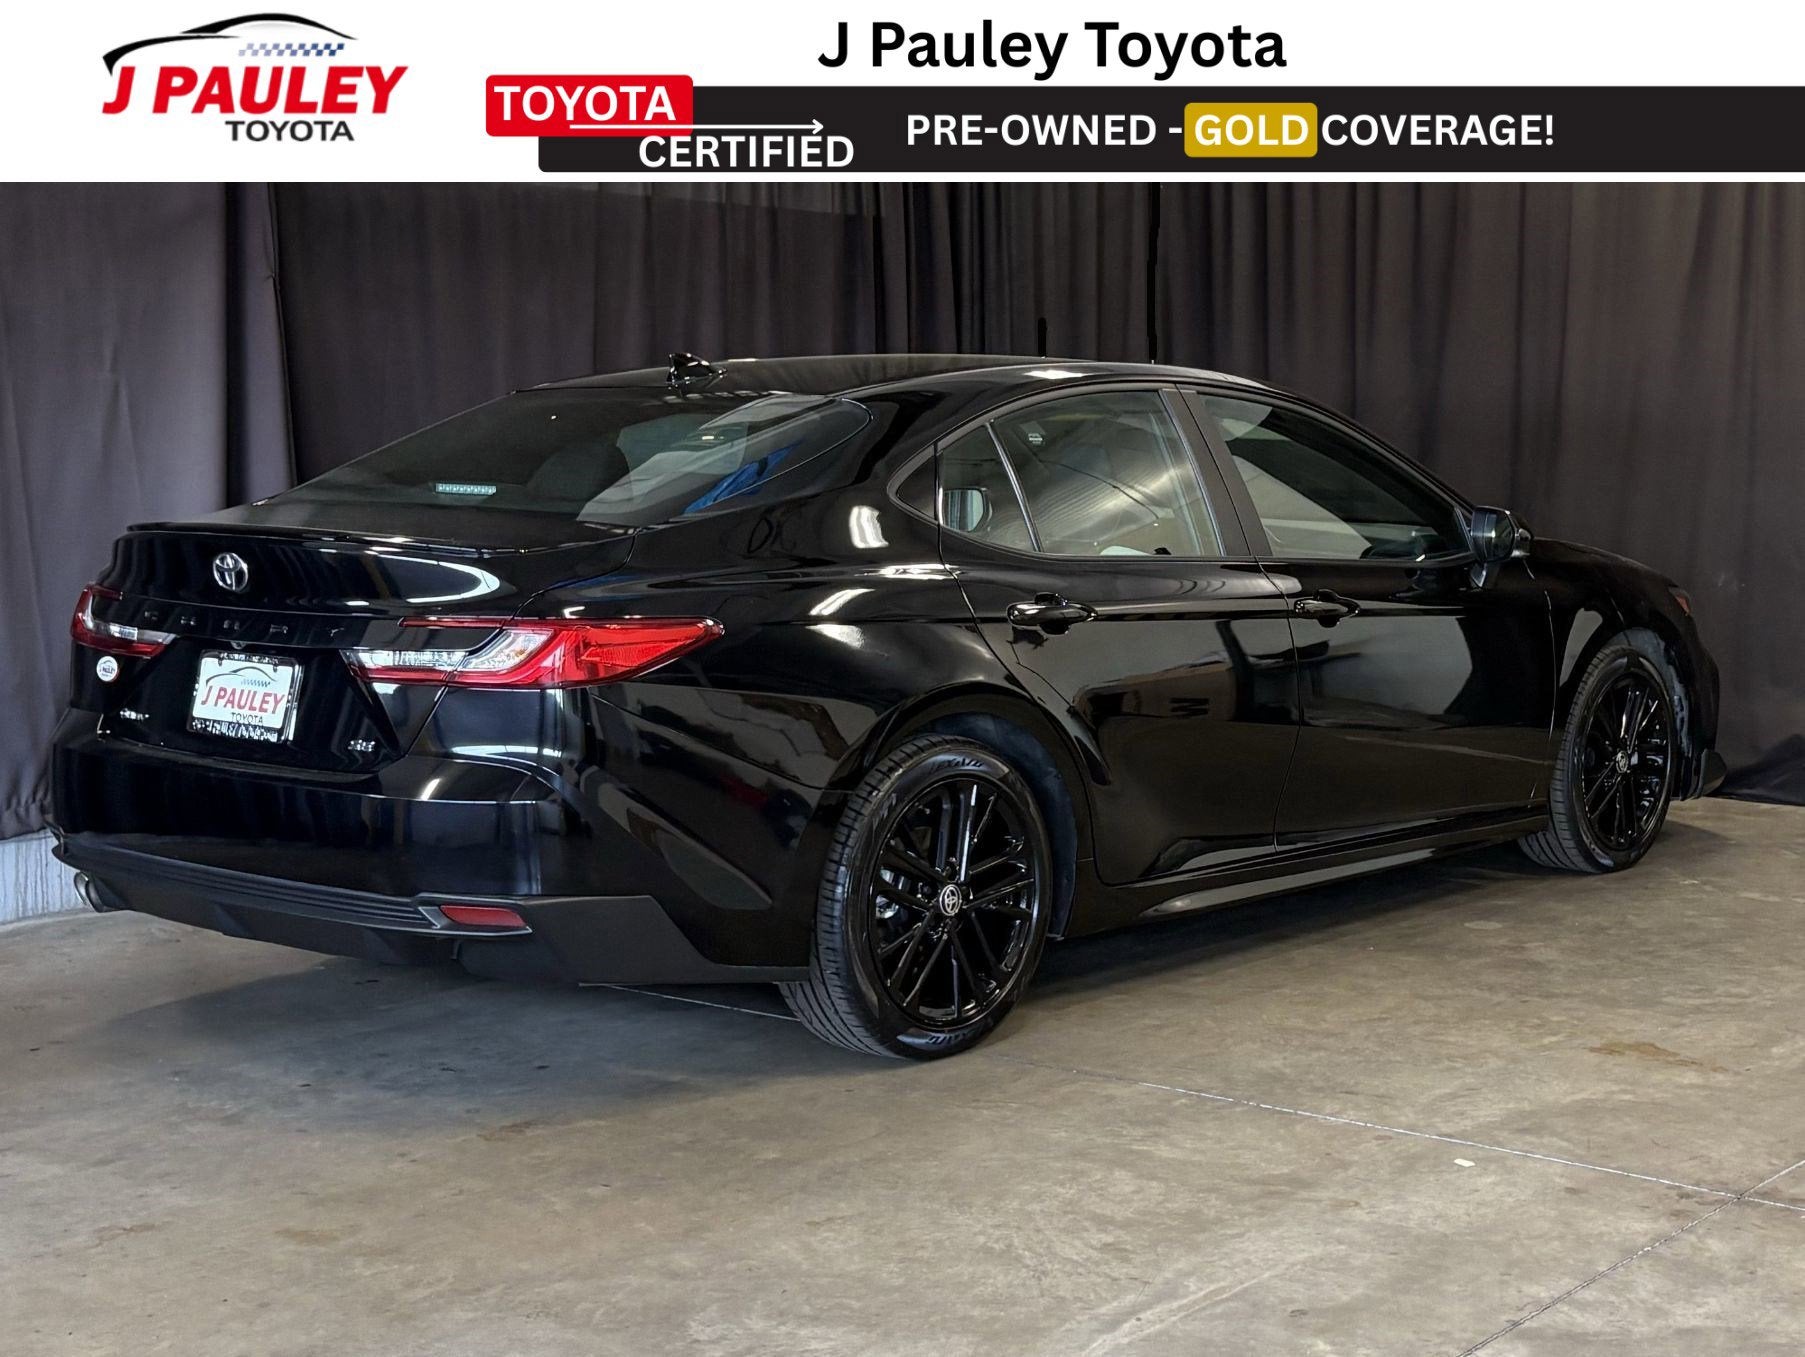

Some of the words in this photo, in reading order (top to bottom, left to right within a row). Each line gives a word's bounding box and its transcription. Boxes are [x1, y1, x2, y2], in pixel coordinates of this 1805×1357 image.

[201, 685, 213, 706] J
[214, 686, 285, 715] PAULEY
[231, 712, 263, 724] TOYOTA
